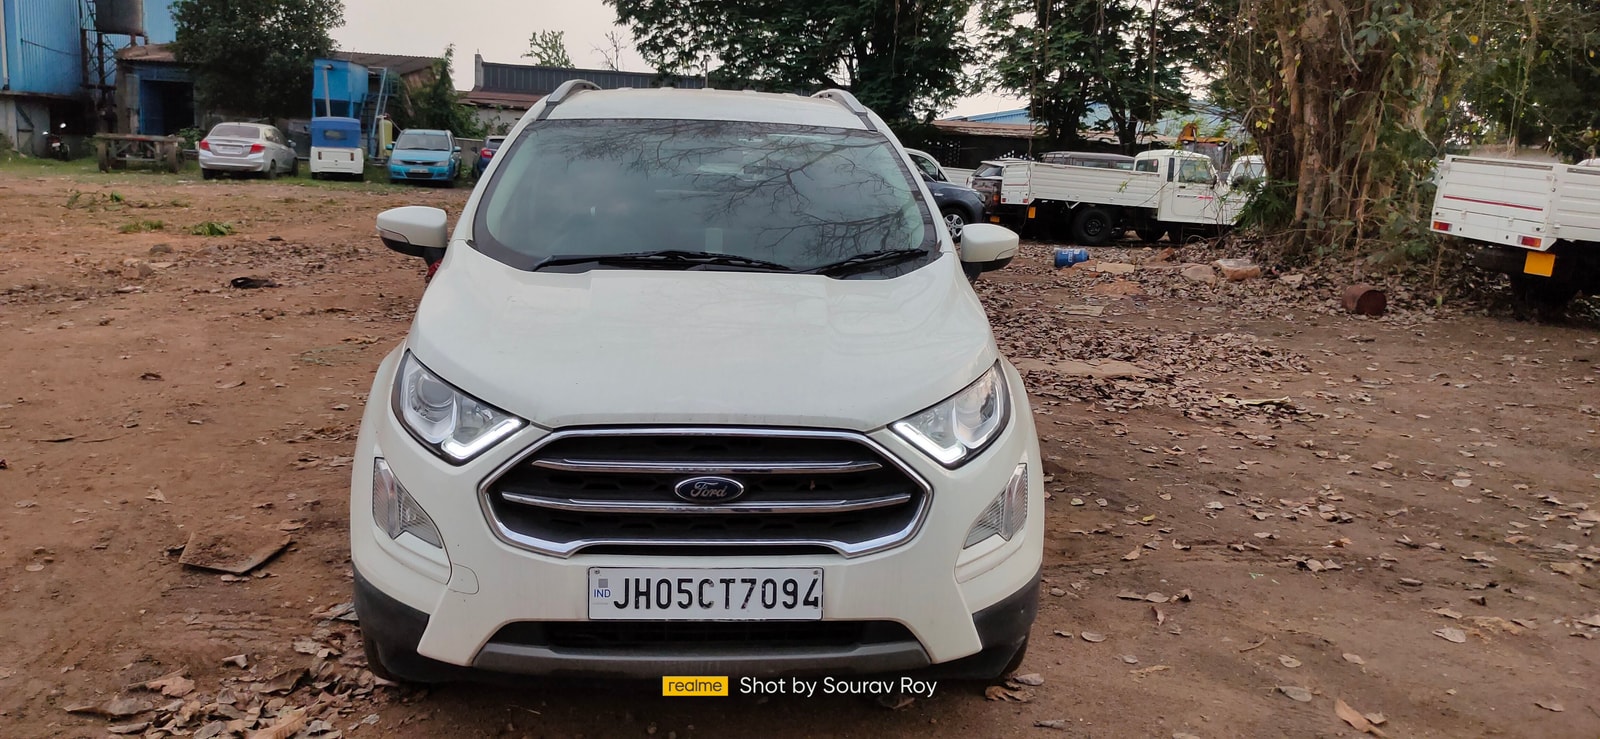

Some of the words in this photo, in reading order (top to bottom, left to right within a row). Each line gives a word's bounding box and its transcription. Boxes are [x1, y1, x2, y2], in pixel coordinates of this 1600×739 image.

[690, 481, 728, 497] Ford
[593, 589, 611, 598] IND
[613, 578, 819, 609] JH05CT7094
